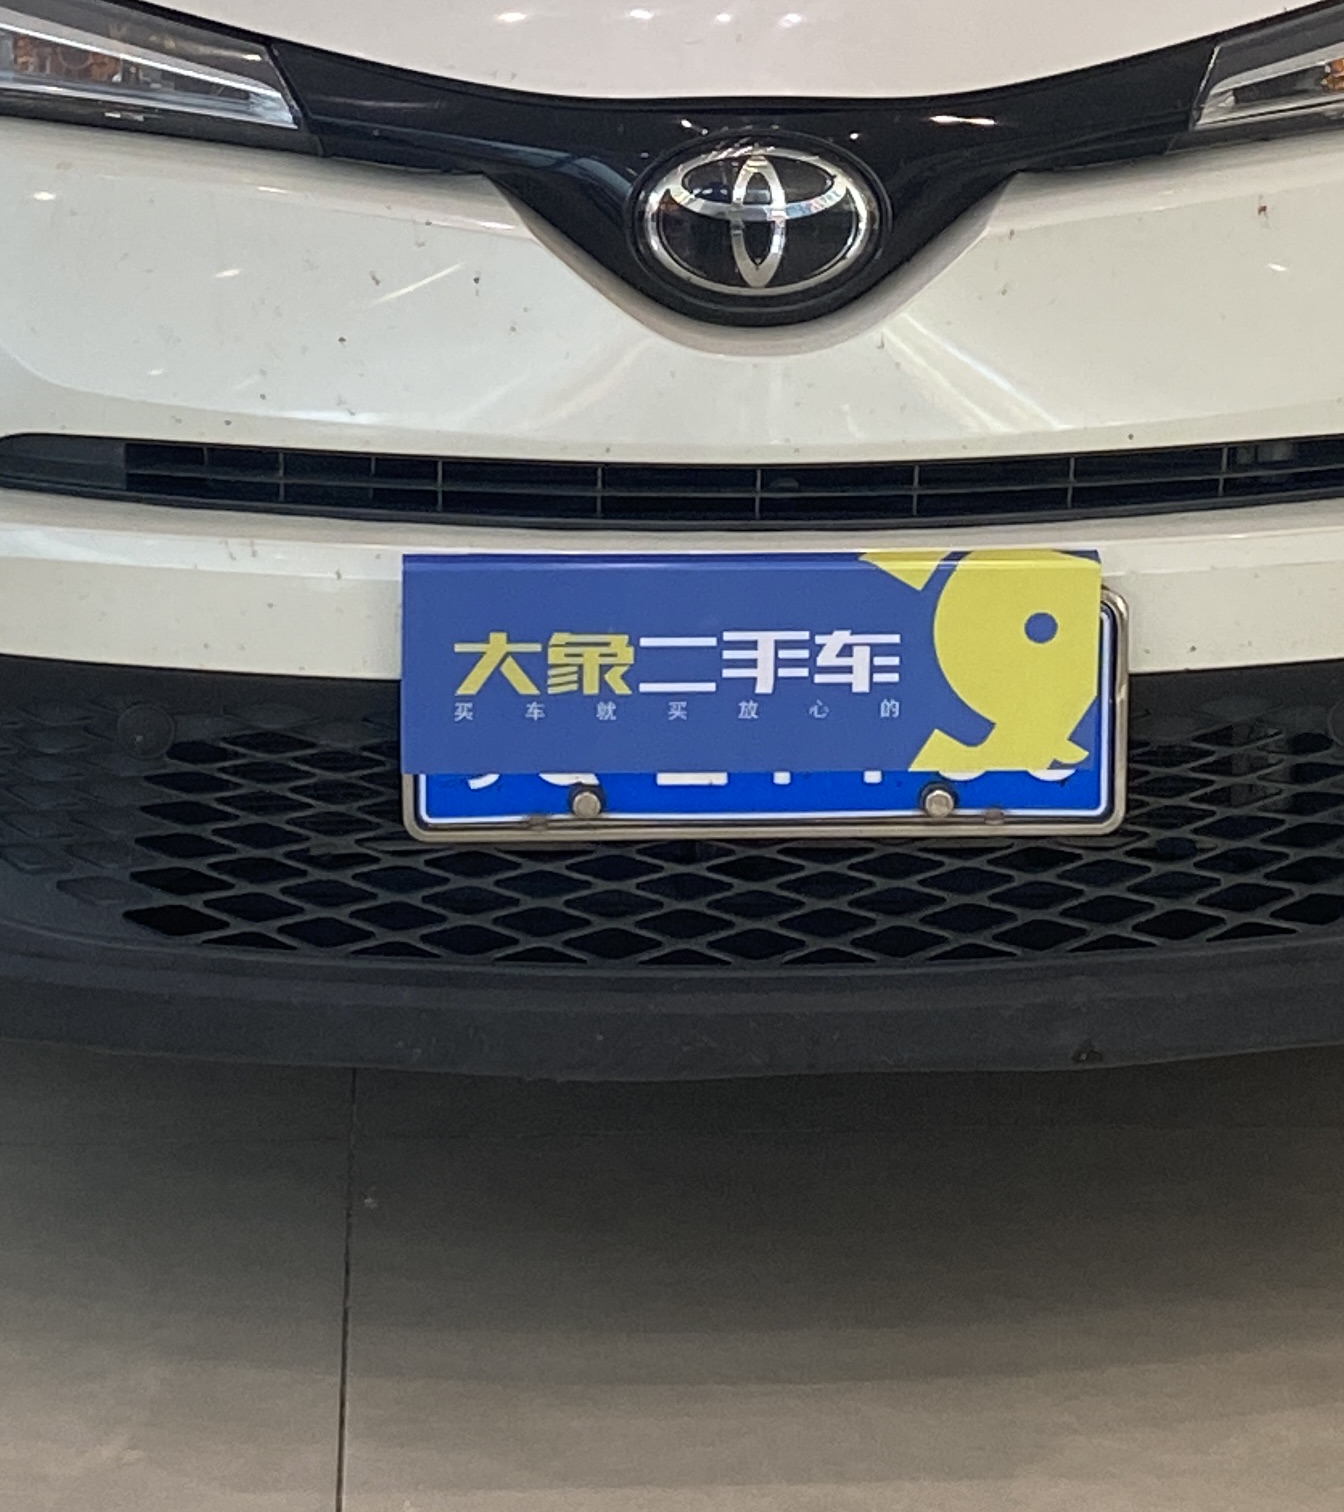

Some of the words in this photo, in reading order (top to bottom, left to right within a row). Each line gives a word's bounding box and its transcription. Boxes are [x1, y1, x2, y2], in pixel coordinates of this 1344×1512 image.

[453, 630, 902, 696] 大象二手车
[454, 698, 902, 721] 买车就买放心的
